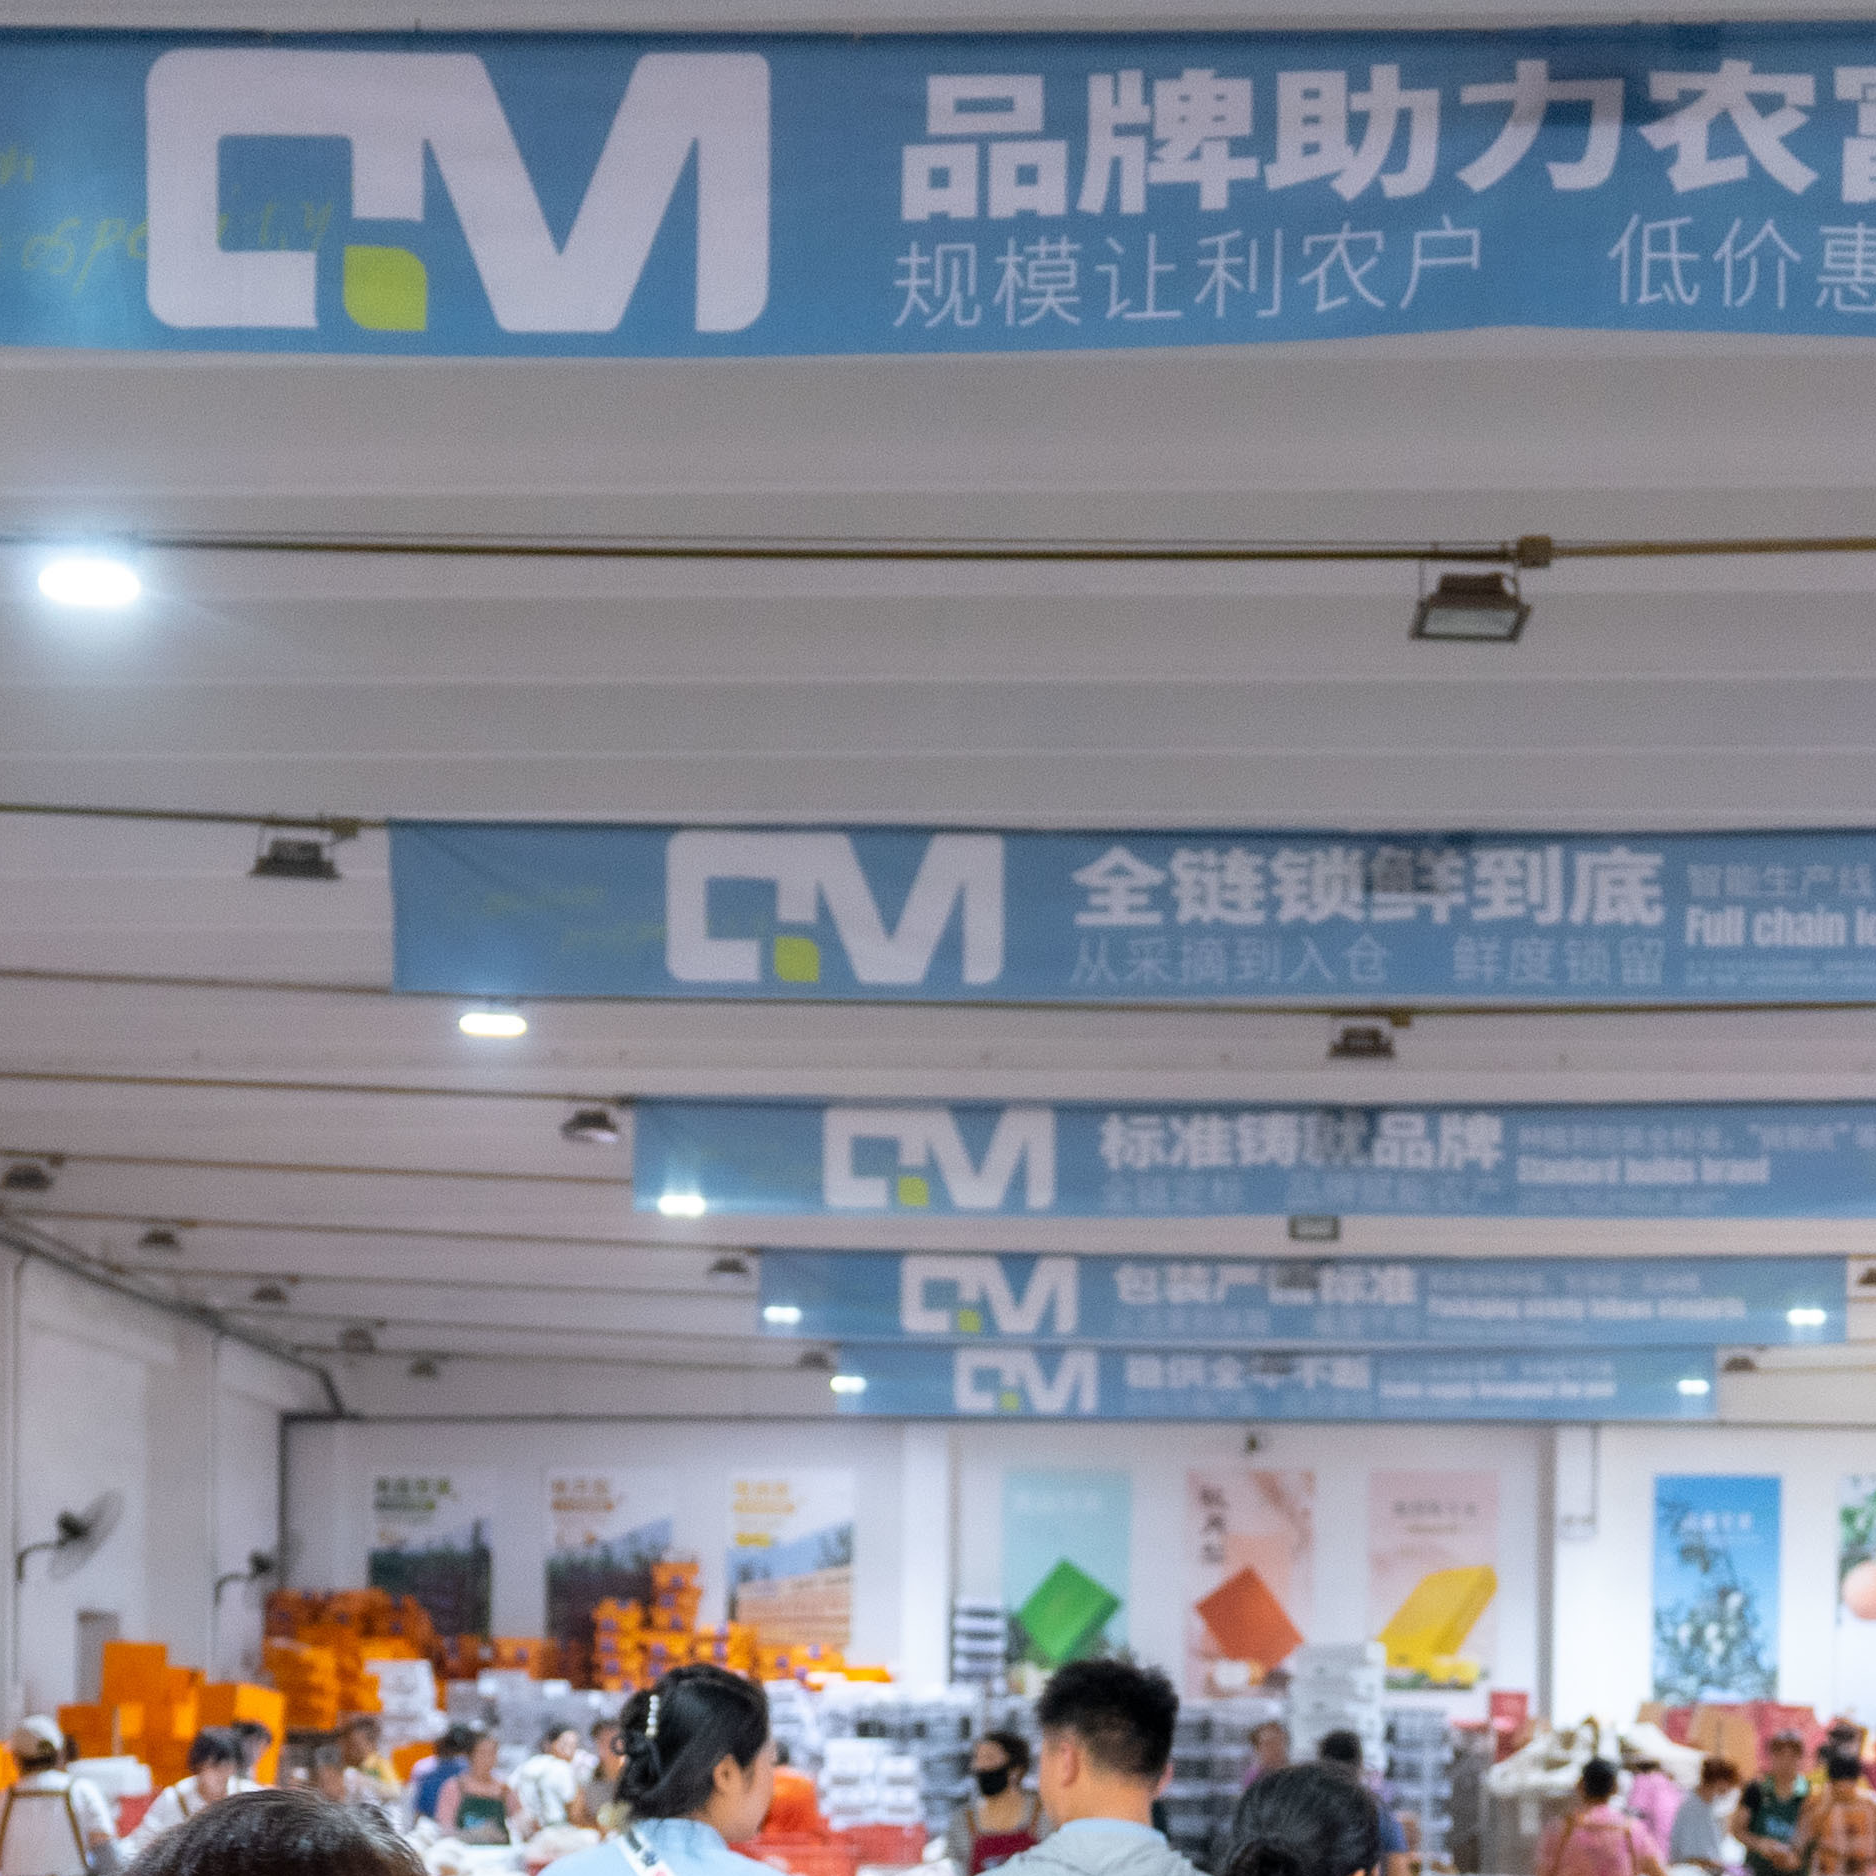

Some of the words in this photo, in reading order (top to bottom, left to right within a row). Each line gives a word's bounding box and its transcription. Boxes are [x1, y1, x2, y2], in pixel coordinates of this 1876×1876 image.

[891, 213, 1485, 330] 规模让利农户
[1070, 844, 1666, 927] 全链锁鲜到底
[1069, 934, 1391, 984] 从采摘到入仓
[1685, 905, 1745, 948] Full
[1753, 904, 1847, 948] chain
